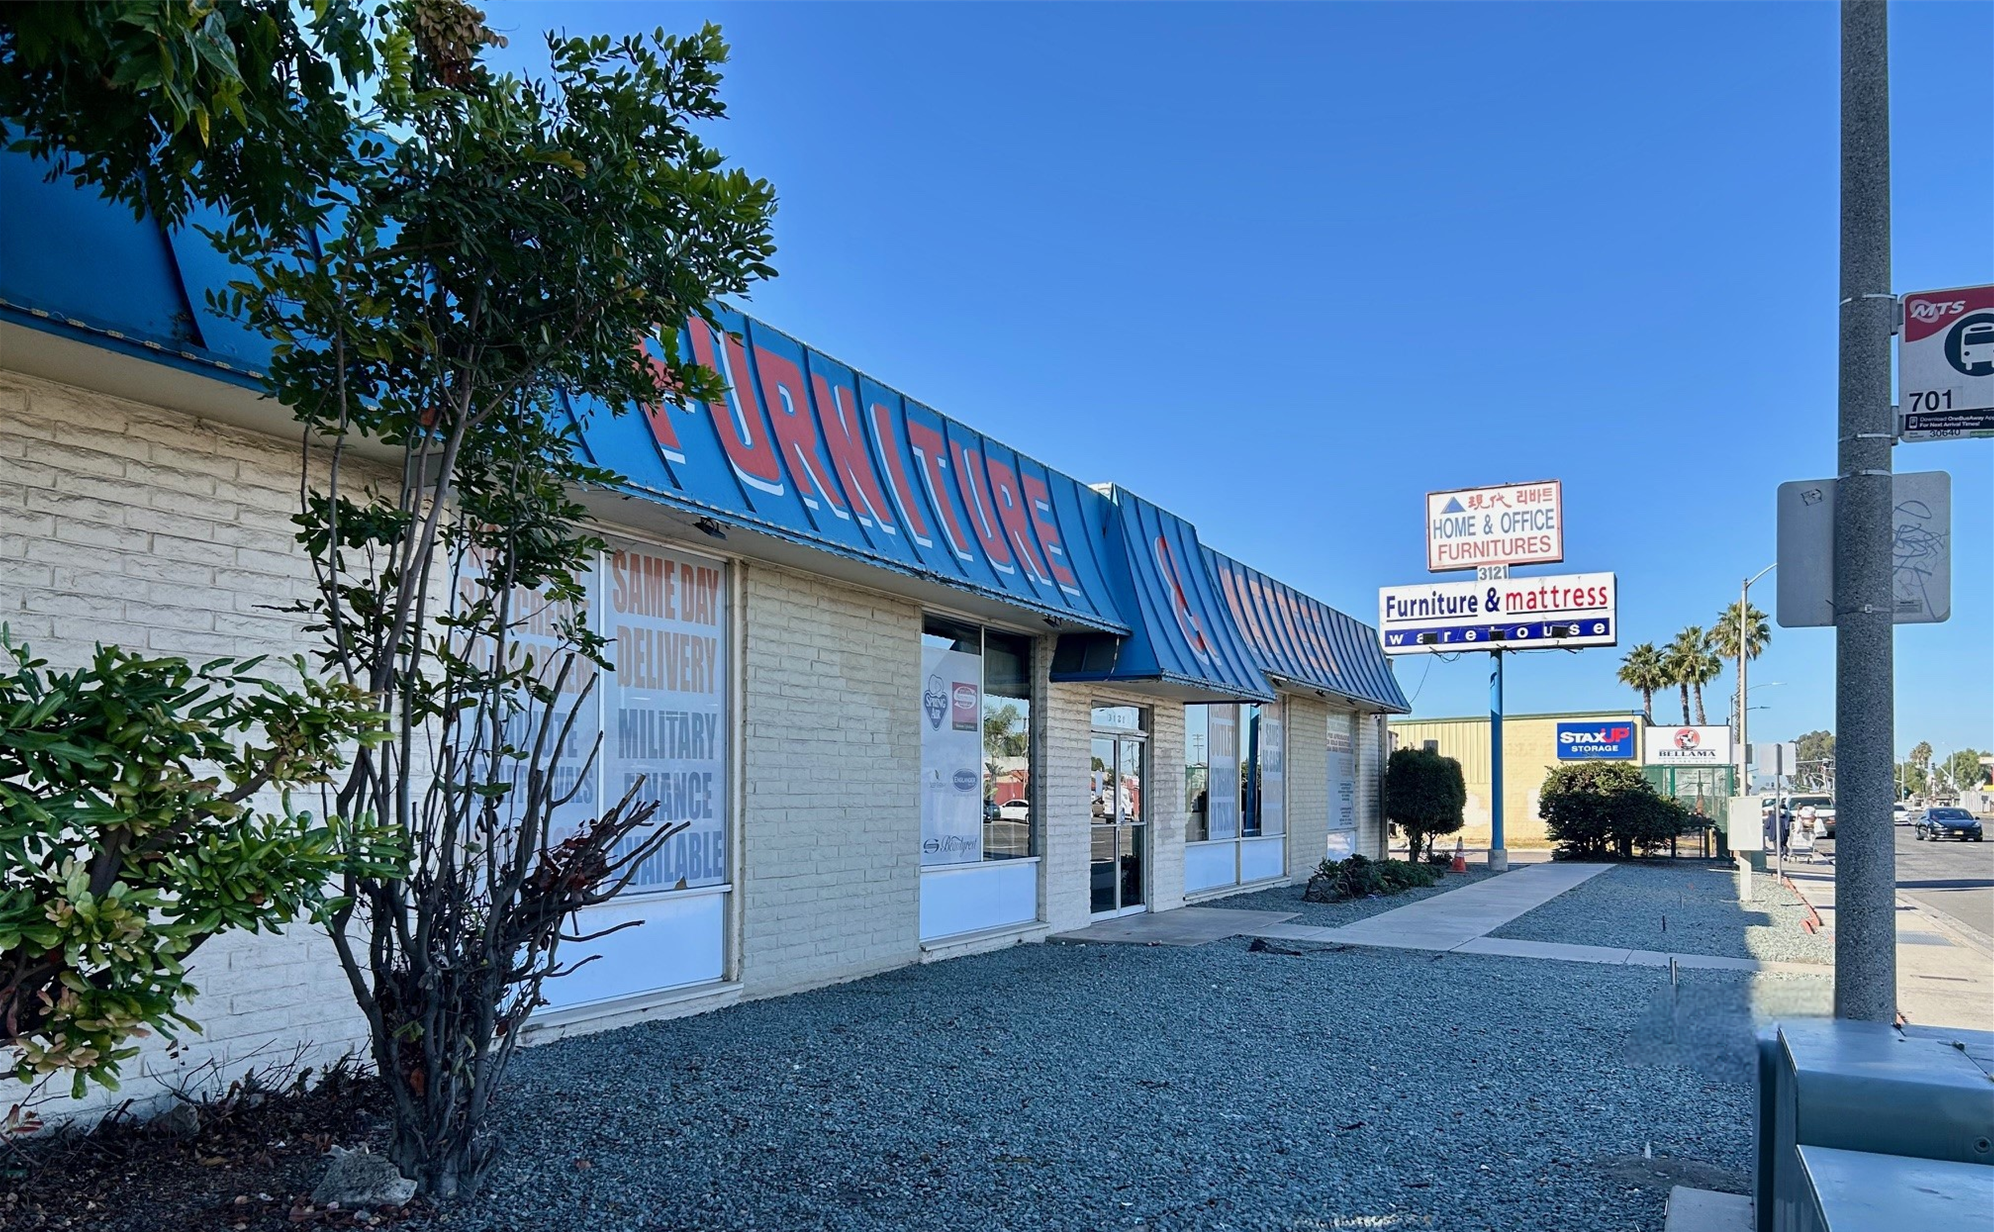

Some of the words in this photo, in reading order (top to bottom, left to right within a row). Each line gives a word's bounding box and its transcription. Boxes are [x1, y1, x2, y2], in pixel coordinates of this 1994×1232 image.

[1910, 300, 1966, 318] MTS
[1909, 389, 1952, 413] 701
[1929, 429, 1961, 438] 30640
[1516, 487, 1553, 506] 리바트
[1433, 515, 1477, 539] HOME
[1483, 514, 1493, 535] &
[1500, 508, 1555, 534] OFFICE
[1438, 535, 1551, 561] FURNITURES
[1478, 565, 1508, 581] 3121
[612, 549, 676, 620] SAME
[681, 563, 719, 626] DAY
[1386, 590, 1478, 618] Furniture
[1485, 587, 1500, 613] &
[1506, 585, 1608, 611] mattress
[1389, 622, 1606, 646] wareouse
[617, 625, 717, 694] DELIVERY
[618, 709, 717, 760] MILITARY
[624, 772, 713, 821] FINANCE
